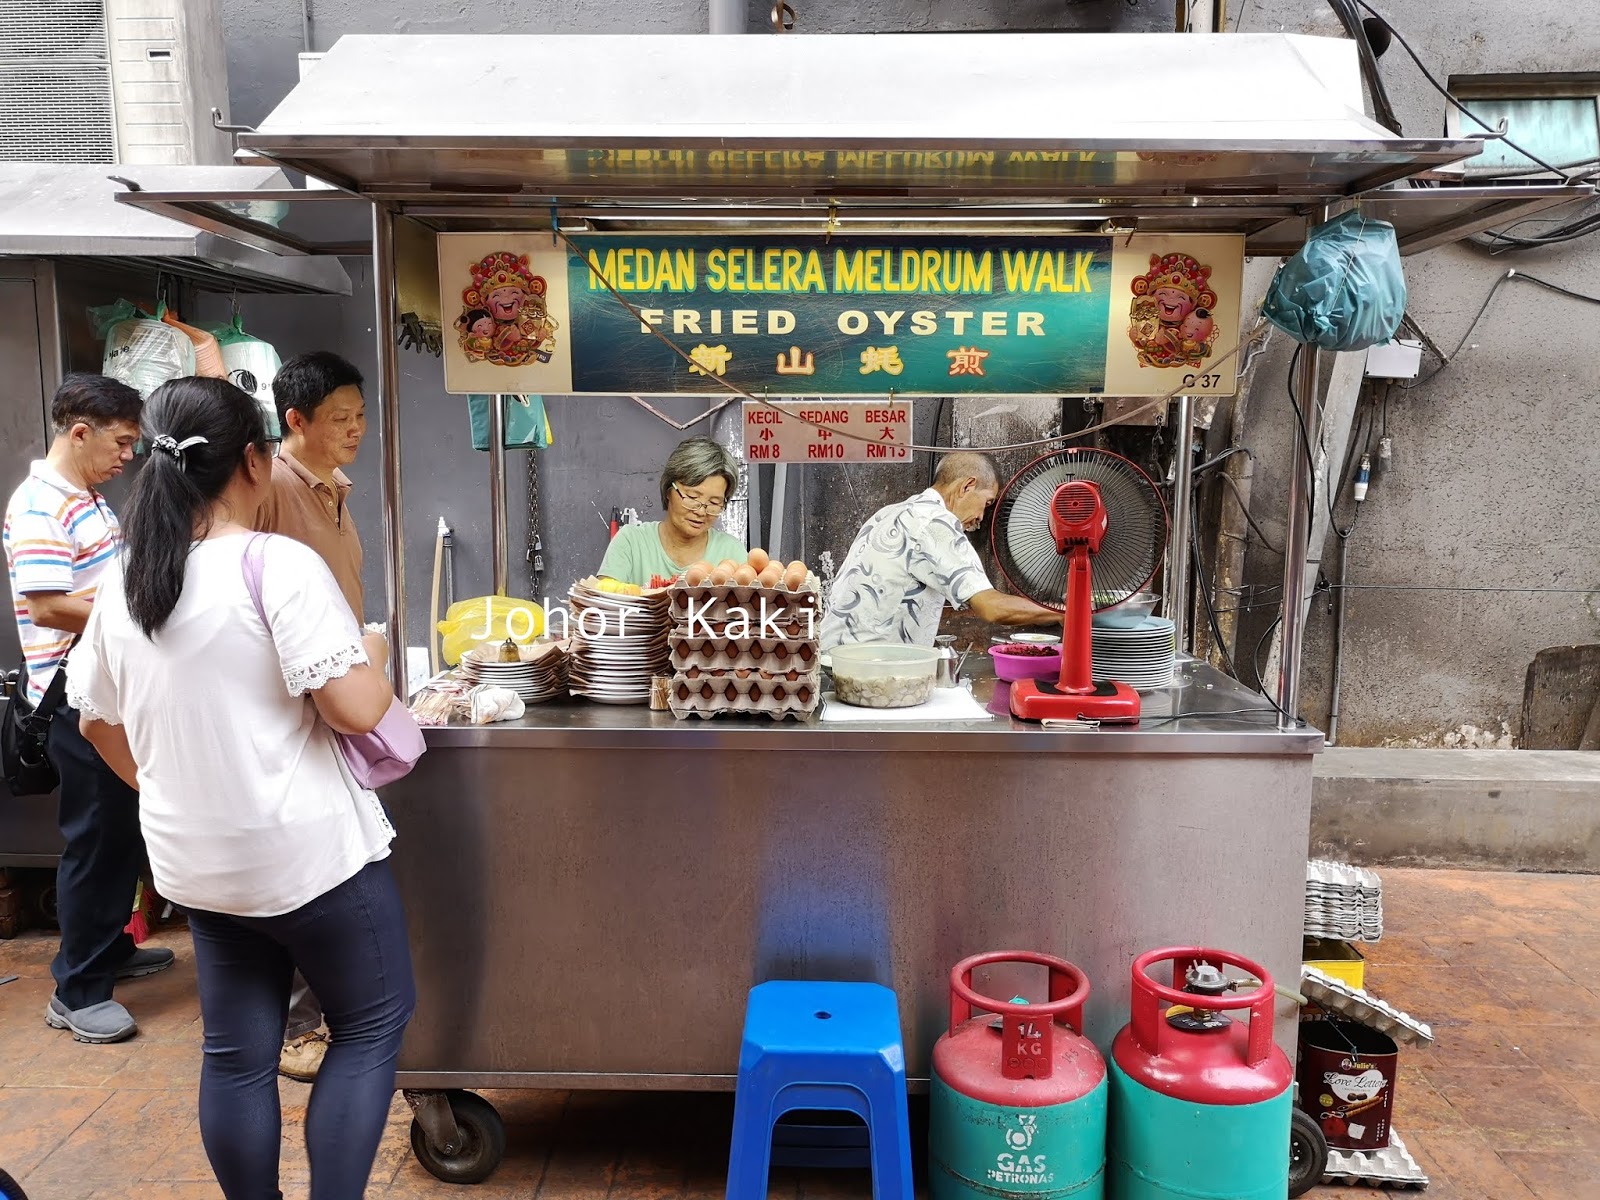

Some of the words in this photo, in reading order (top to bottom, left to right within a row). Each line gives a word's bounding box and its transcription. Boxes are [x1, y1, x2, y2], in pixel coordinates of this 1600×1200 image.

[588, 248, 695, 292] MEDAN
[707, 248, 825, 292] SELERA
[835, 249, 992, 293] MELDRUM
[1002, 250, 1093, 293] WALK
[640, 309, 796, 335] FRIED
[837, 310, 1046, 336] OYSTER
[1201, 374, 1221, 388] 37
[748, 411, 783, 424] KECIL
[800, 410, 849, 424] SEDANG
[866, 410, 906, 423] BESAR
[759, 427, 774, 441] 小
[879, 427, 895, 440] 大
[808, 444, 844, 458] RM10
[1017, 1022, 1042, 1040] 14
[1017, 1043, 1042, 1056] KG
[1323, 1071, 1352, 1087] Love
[996, 1152, 1047, 1173] GAS
[987, 1169, 1054, 1184] PETRONAS
